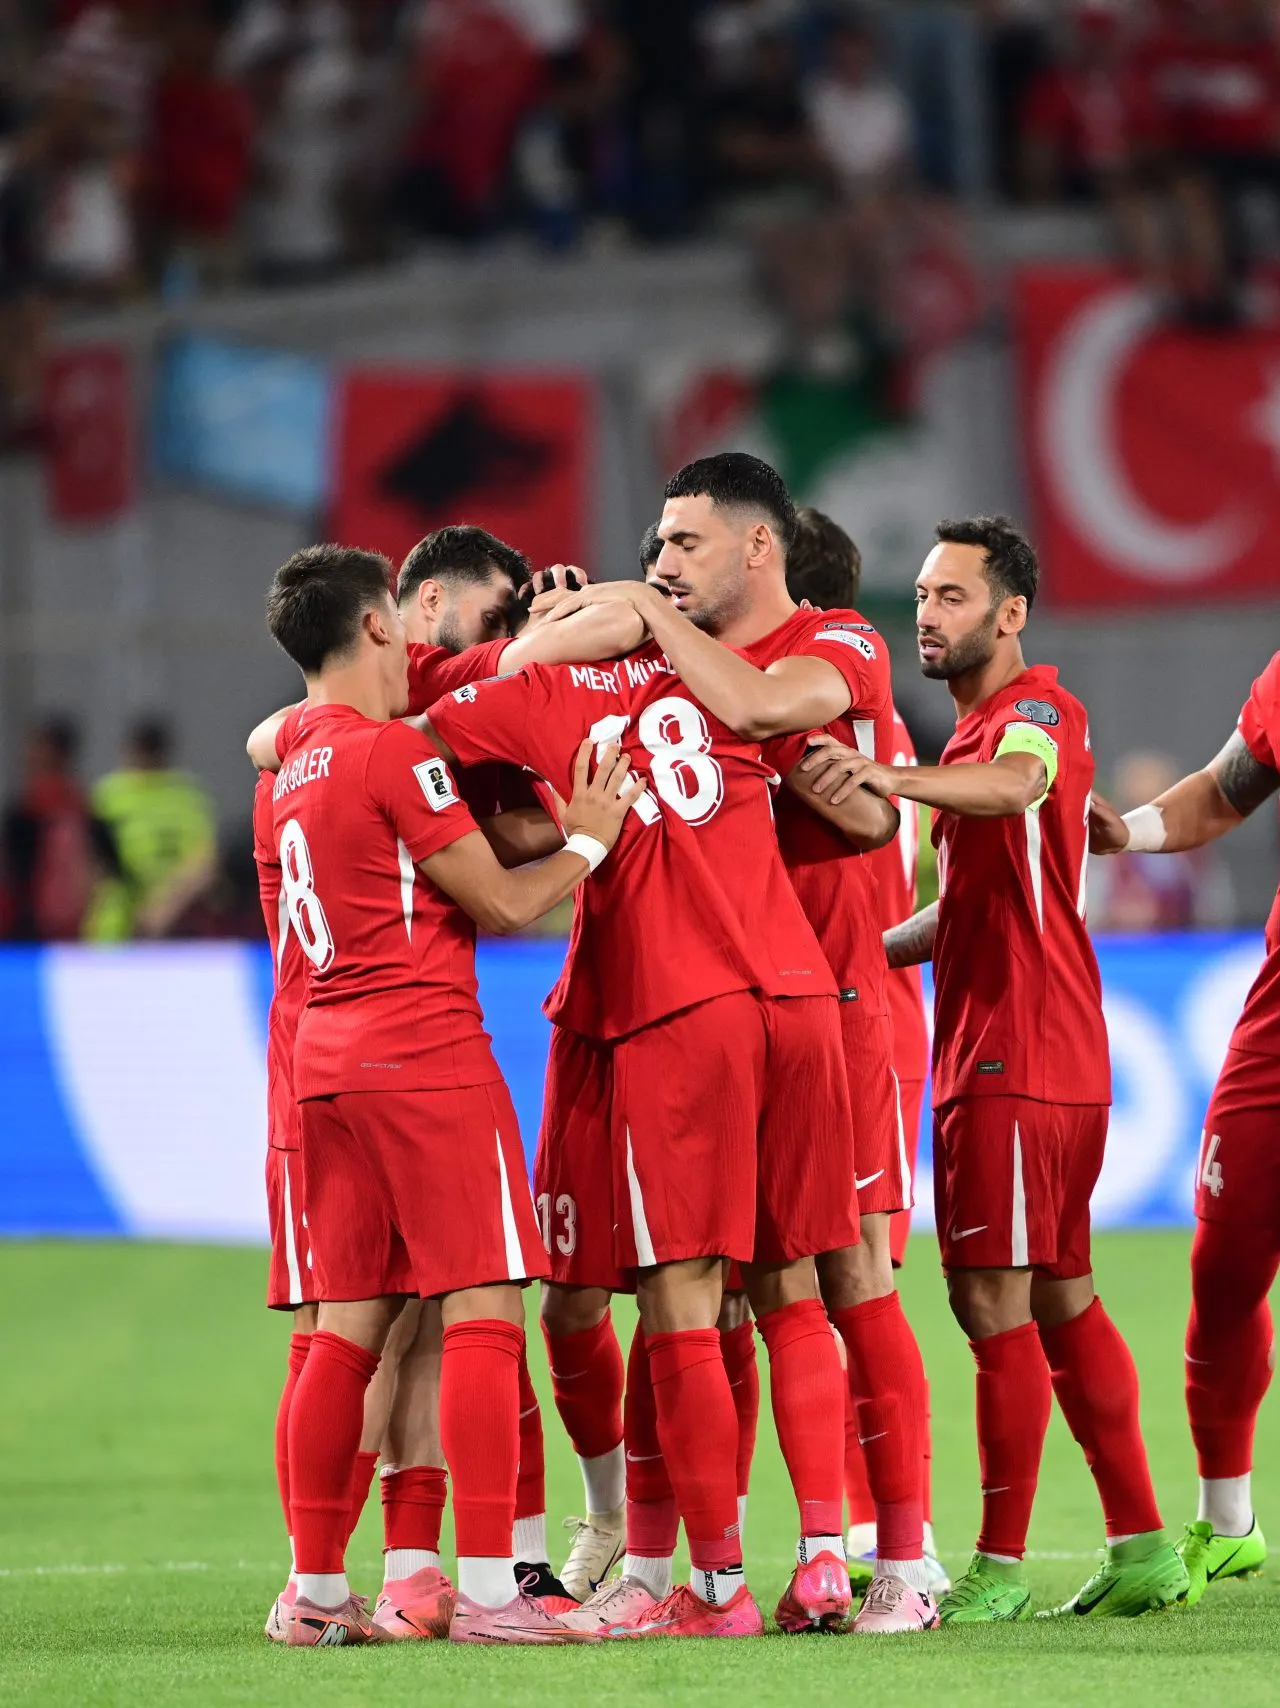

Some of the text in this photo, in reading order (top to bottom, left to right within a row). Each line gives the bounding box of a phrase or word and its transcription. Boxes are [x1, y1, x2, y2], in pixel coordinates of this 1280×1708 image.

[288, 746, 333, 791] GÜLER
[279, 818, 335, 973] 8
[536, 1192, 577, 1257] 13
